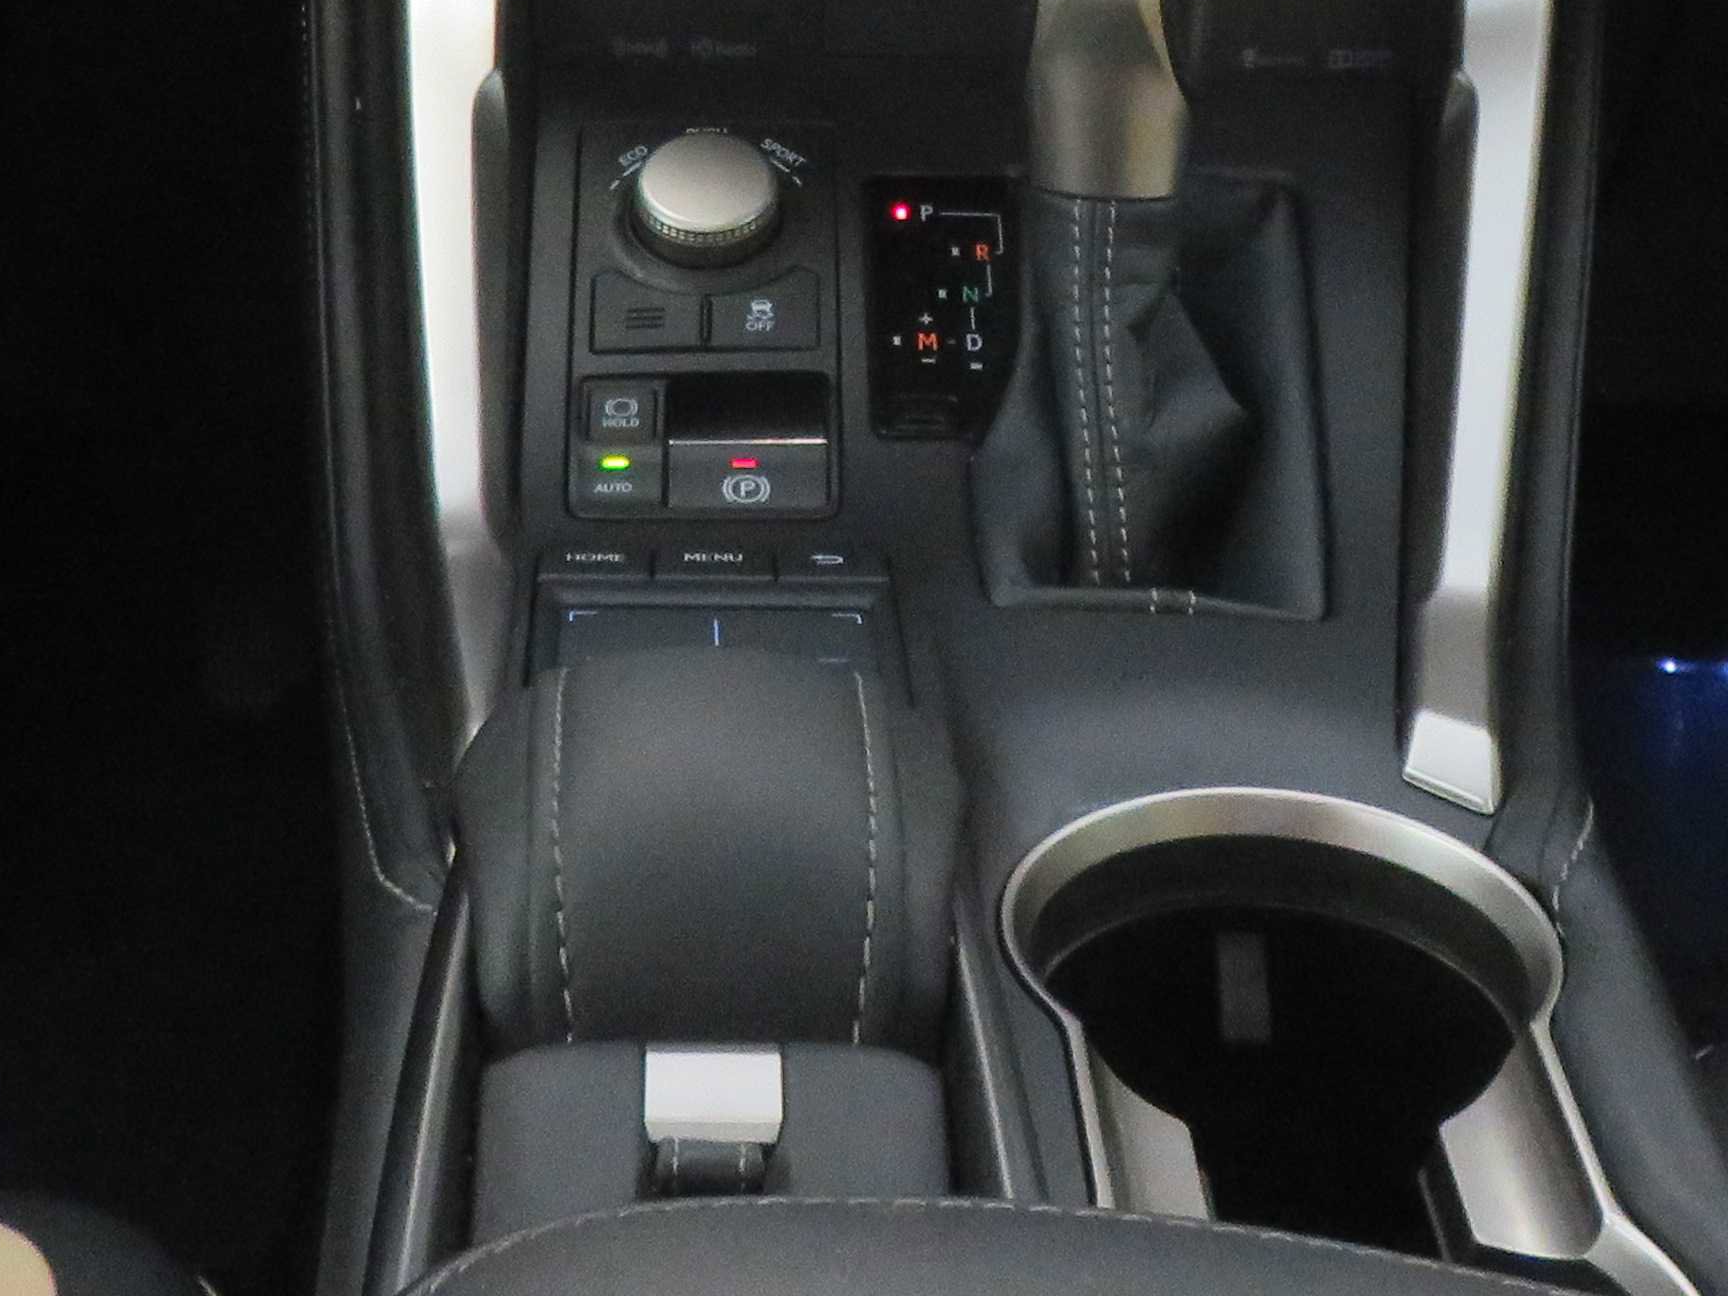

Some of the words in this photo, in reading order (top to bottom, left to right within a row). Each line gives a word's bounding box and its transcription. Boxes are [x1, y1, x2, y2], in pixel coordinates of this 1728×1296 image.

[618, 145, 649, 167] ECO
[760, 137, 807, 168] SPORT
[920, 204, 934, 222] P
[976, 244, 991, 261] R
[962, 286, 979, 303] N
[745, 320, 775, 332] OFF
[917, 332, 938, 351] M
[965, 333, 983, 351] D
[602, 417, 639, 428] HOLD
[593, 482, 633, 494] AUTO
[683, 552, 744, 563] MENU
